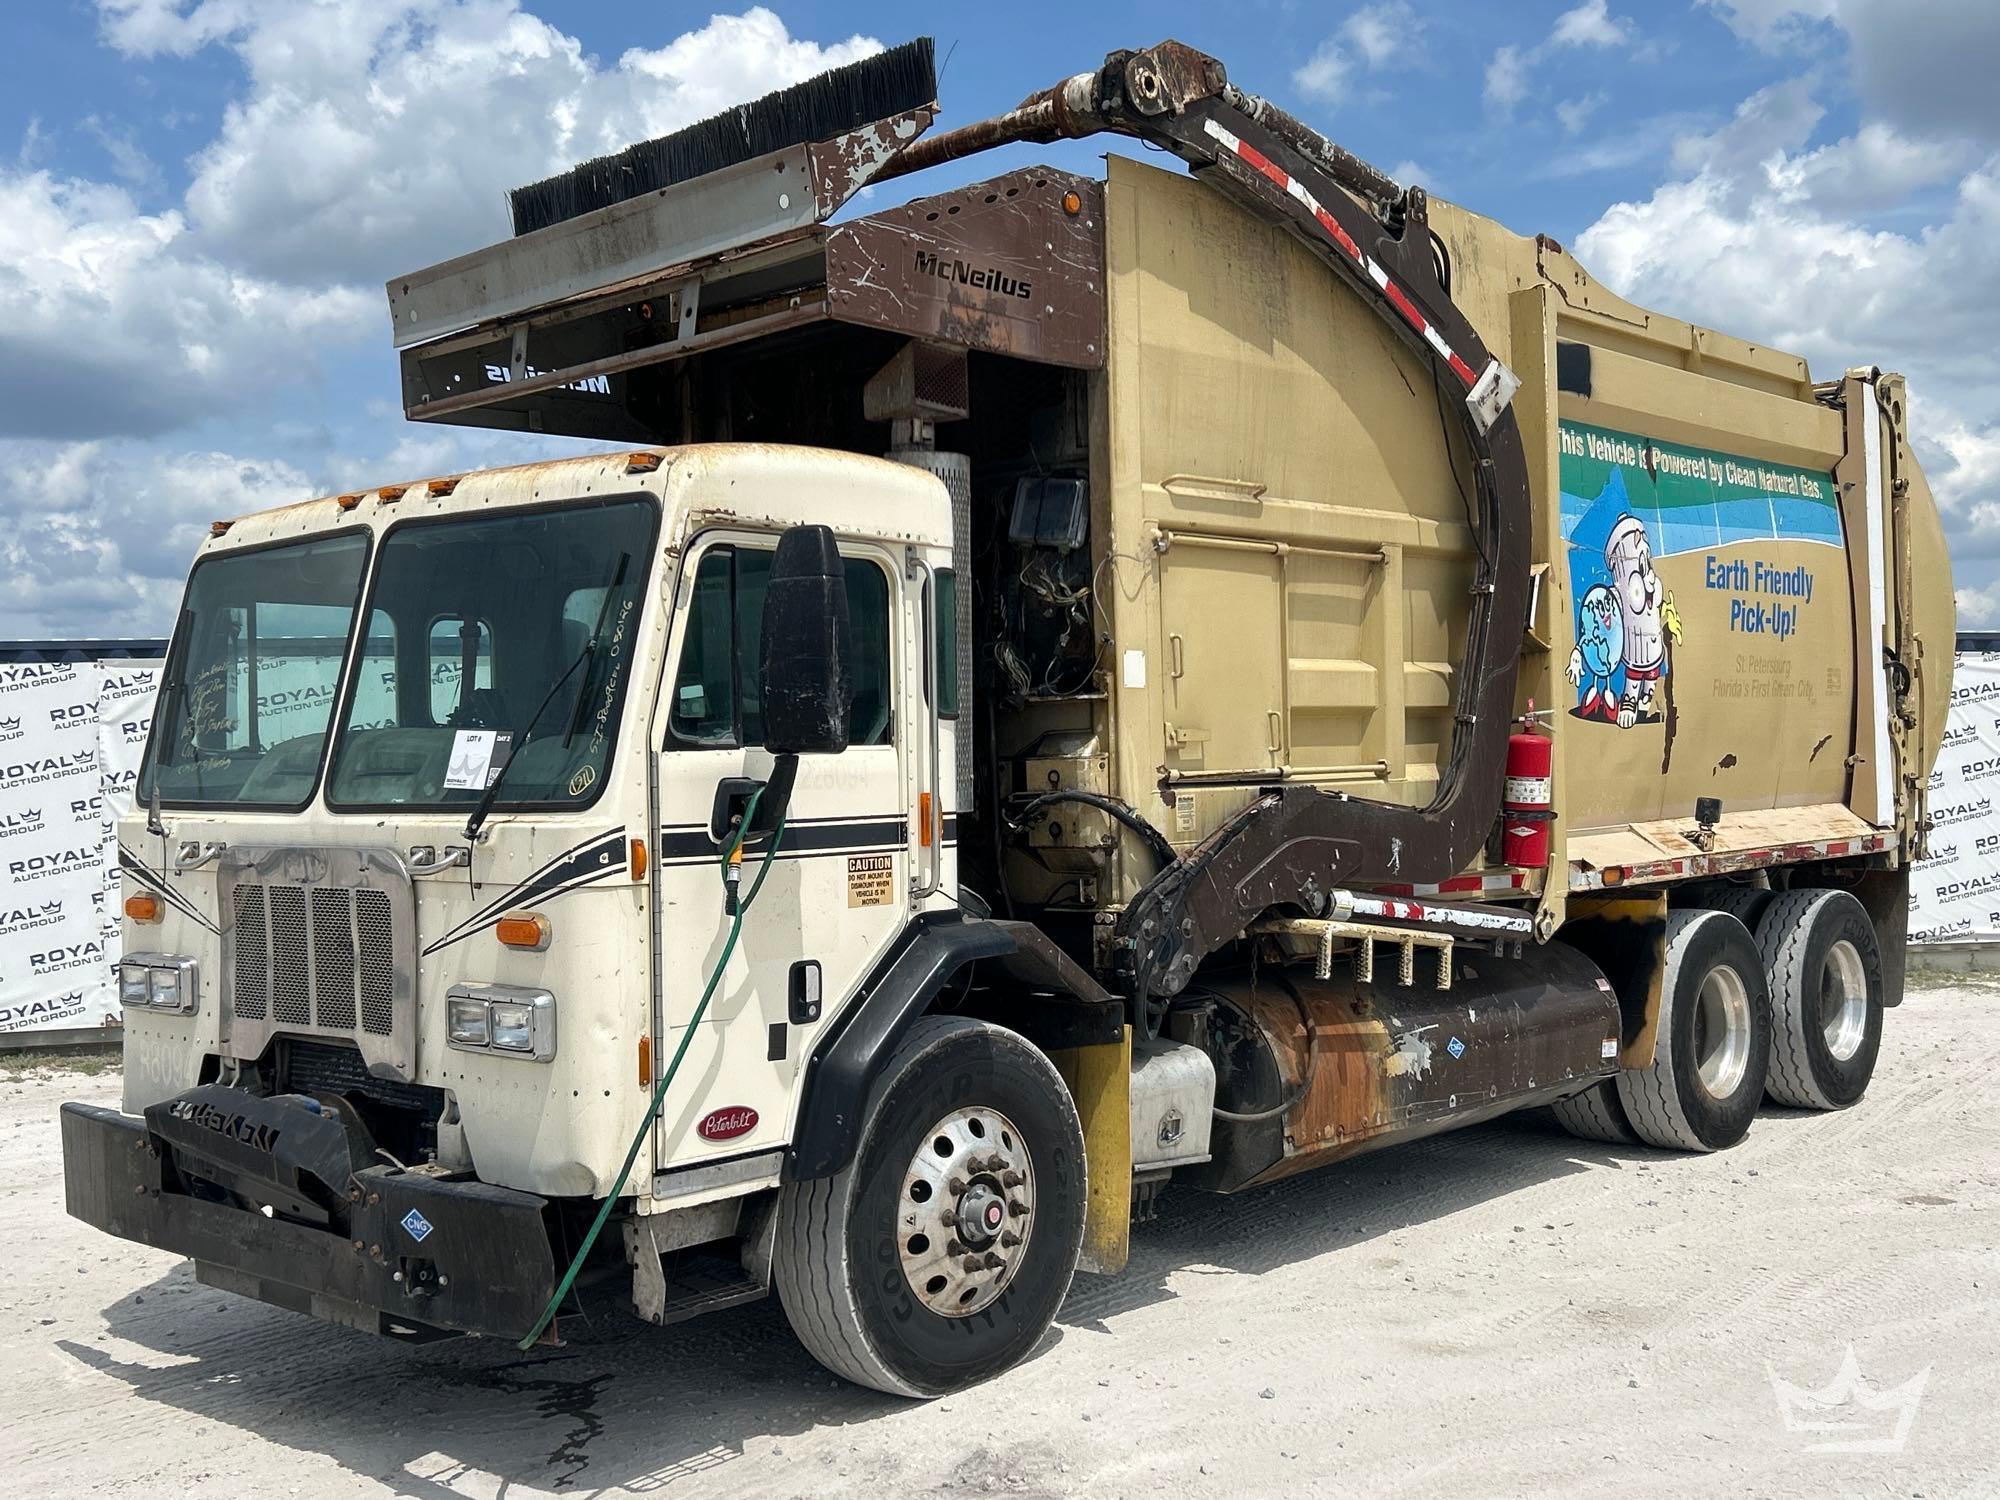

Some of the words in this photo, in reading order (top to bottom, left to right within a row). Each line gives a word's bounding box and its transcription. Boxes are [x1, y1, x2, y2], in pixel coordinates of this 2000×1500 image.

[914, 250, 1032, 299] McNeilus
[1587, 432, 1636, 466] Vehicle
[1652, 446, 1707, 479] Powered
[1708, 457, 1723, 487] by
[1725, 460, 1757, 488] Clean
[1758, 467, 1799, 495] Natural
[1800, 474, 1823, 500] Gas.
[1705, 555, 1749, 591] Earth
[1754, 561, 1814, 604] Friendly
[1730, 599, 1797, 642] Pick-Up!
[0, 665, 52, 683] YAL
[31, 672, 77, 688] GROUP
[113, 685, 157, 699] GROUP
[257, 685, 333, 708] ROYAL
[257, 701, 312, 718] AUCTION
[0, 773, 50, 790] UCTION
[52, 764, 98, 779] GROUP
[9, 848, 94, 874] ROYAL
[849, 857, 891, 871] CAUTION
[13, 865, 71, 884] AUCTION
[1936, 876, 1991, 898] ROYAL
[1938, 890, 1977, 905] AUCTION
[20, 915, 66, 931] GROUP
[34, 957, 91, 976] AUCTION
[41, 1006, 86, 1022] GROUP
[705, 1111, 755, 1135] Peterbilt
[407, 1217, 427, 1231] CNG
